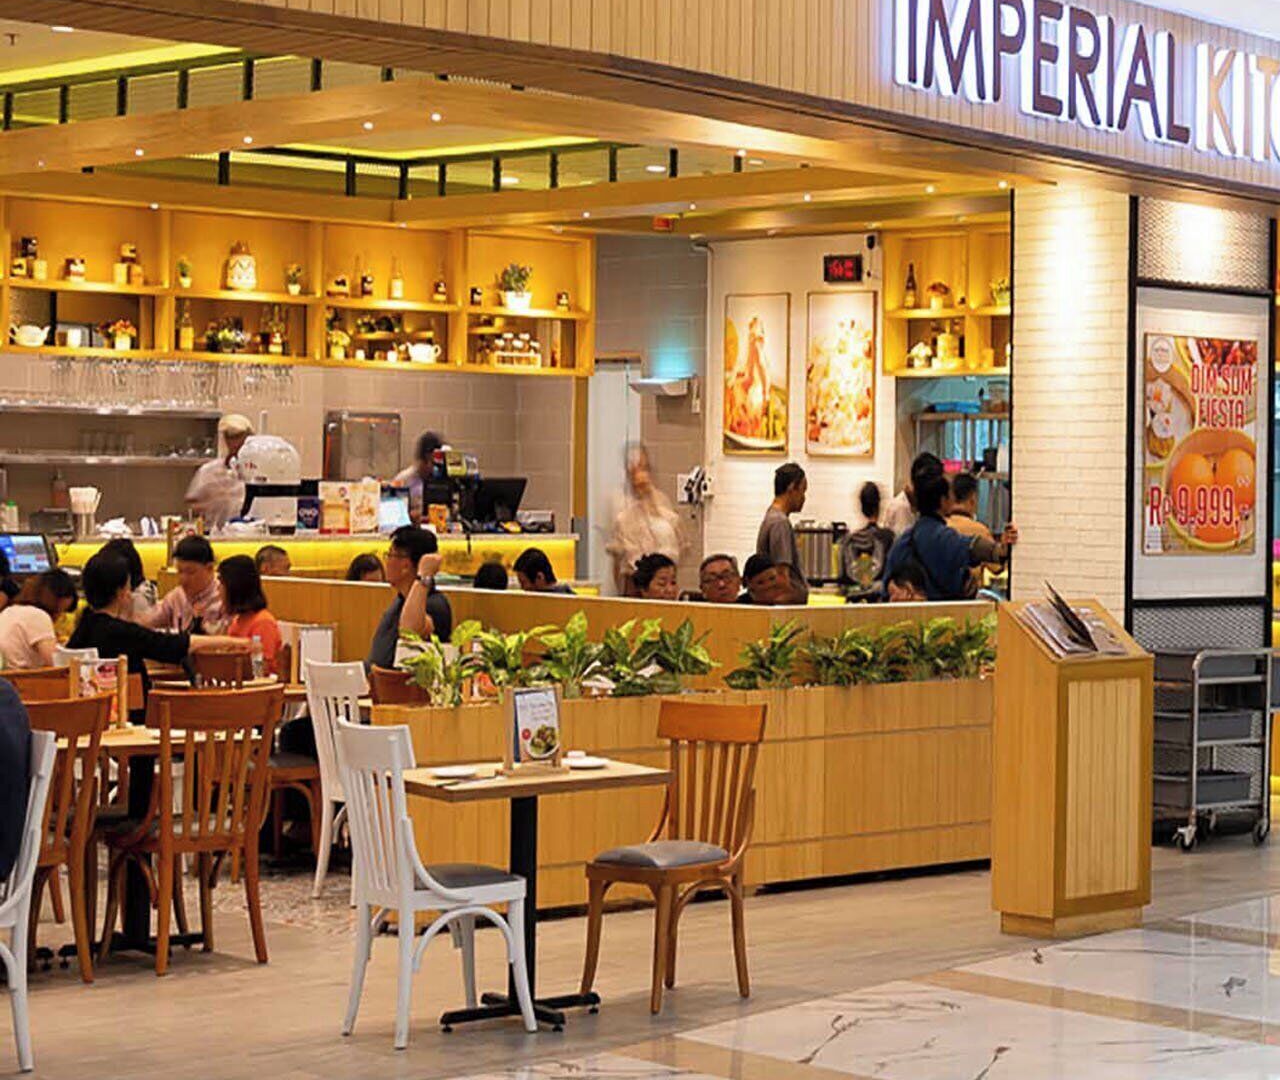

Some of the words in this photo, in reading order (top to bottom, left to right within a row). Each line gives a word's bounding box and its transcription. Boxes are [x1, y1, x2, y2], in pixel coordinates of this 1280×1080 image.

[1191, 364, 1218, 395] DIM
[1222, 364, 1252, 396] SUM
[1198, 398, 1244, 429] FIESTA
